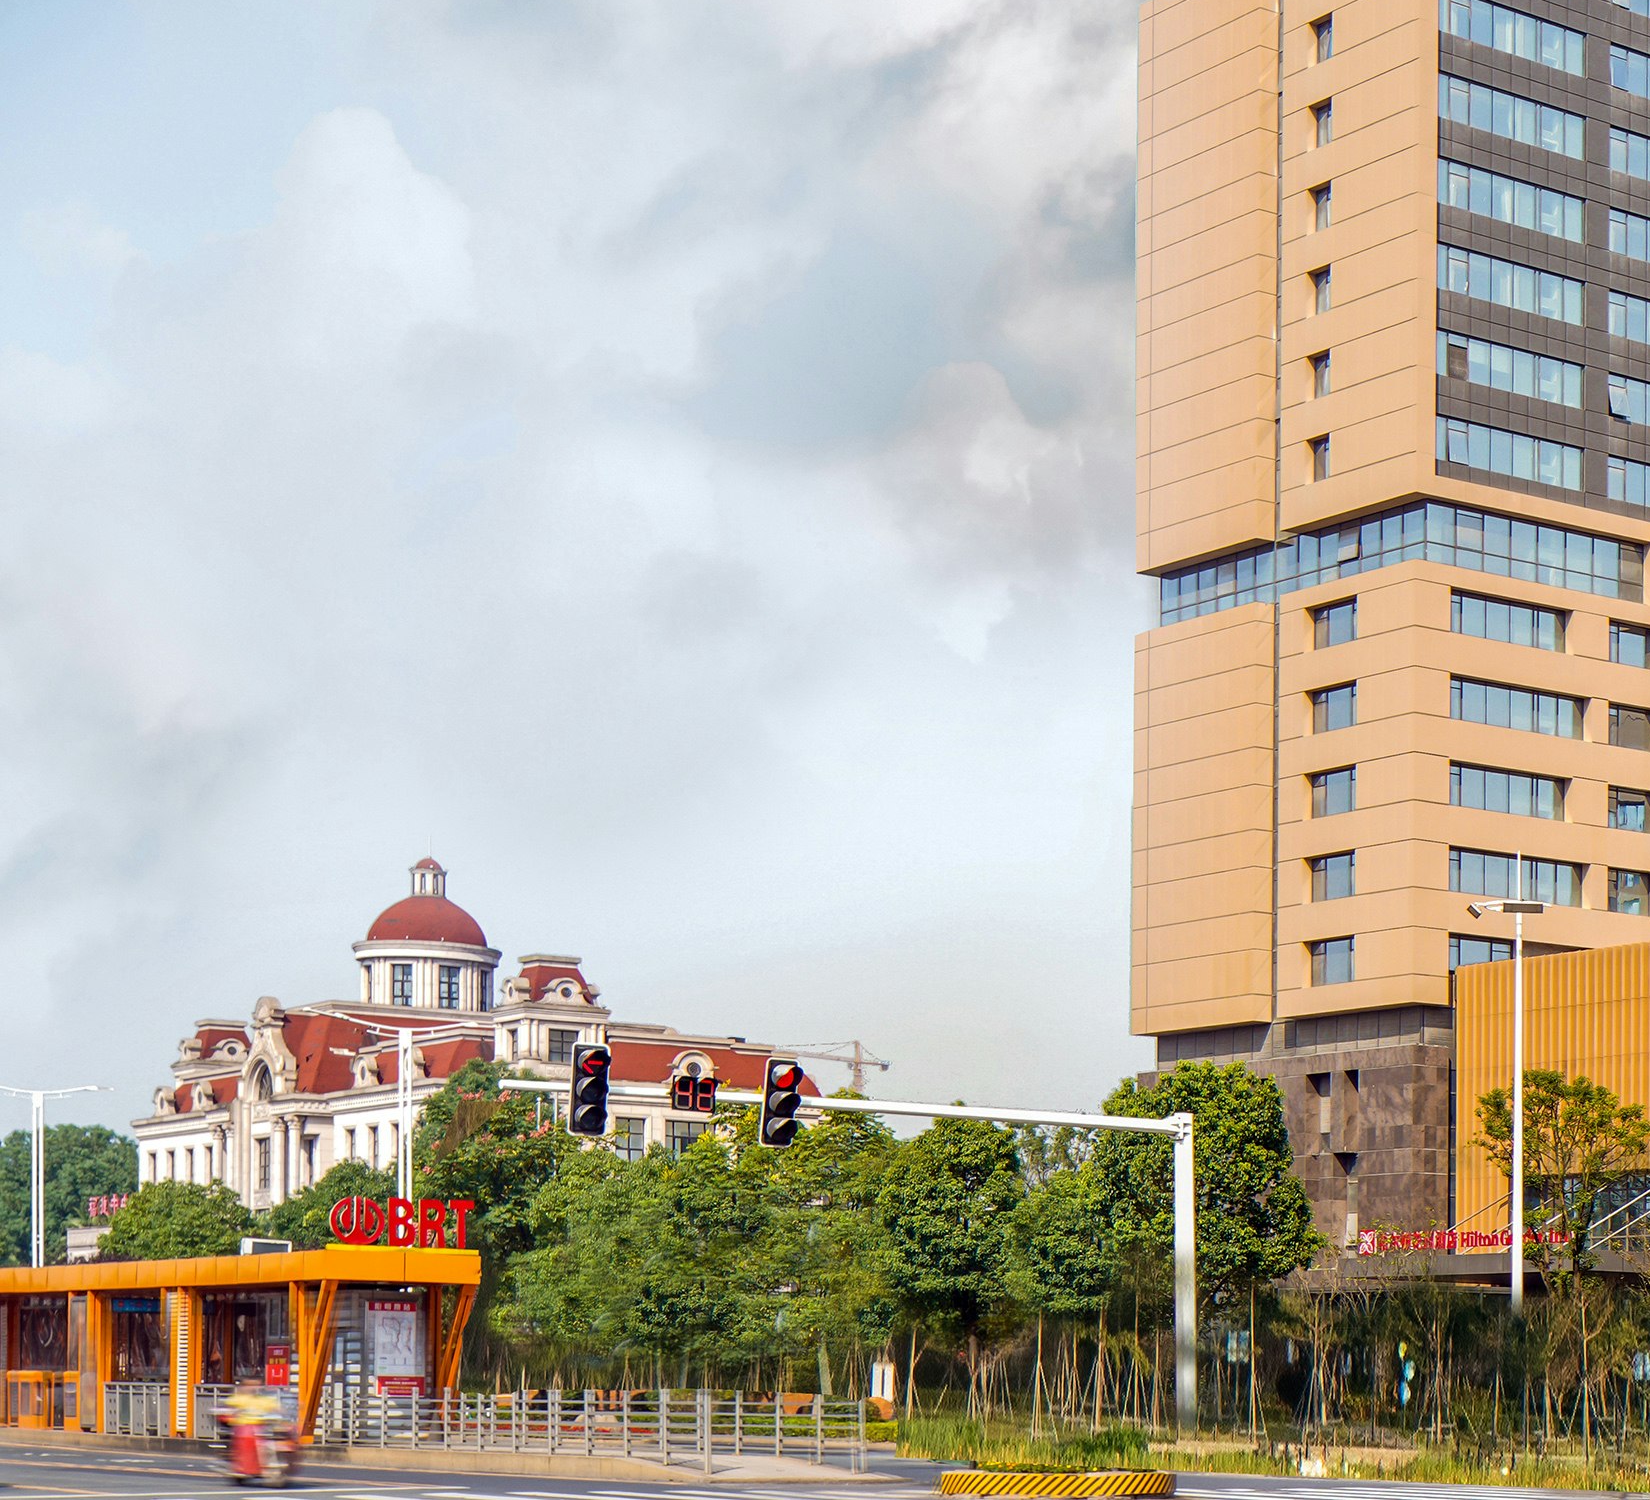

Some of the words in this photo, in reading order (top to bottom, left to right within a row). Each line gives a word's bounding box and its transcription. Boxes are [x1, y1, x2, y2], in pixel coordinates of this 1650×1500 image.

[675, 1079, 714, 1111] 42
[388, 1197, 475, 1248] BRT
[1460, 1230, 1499, 1248] Hilton
